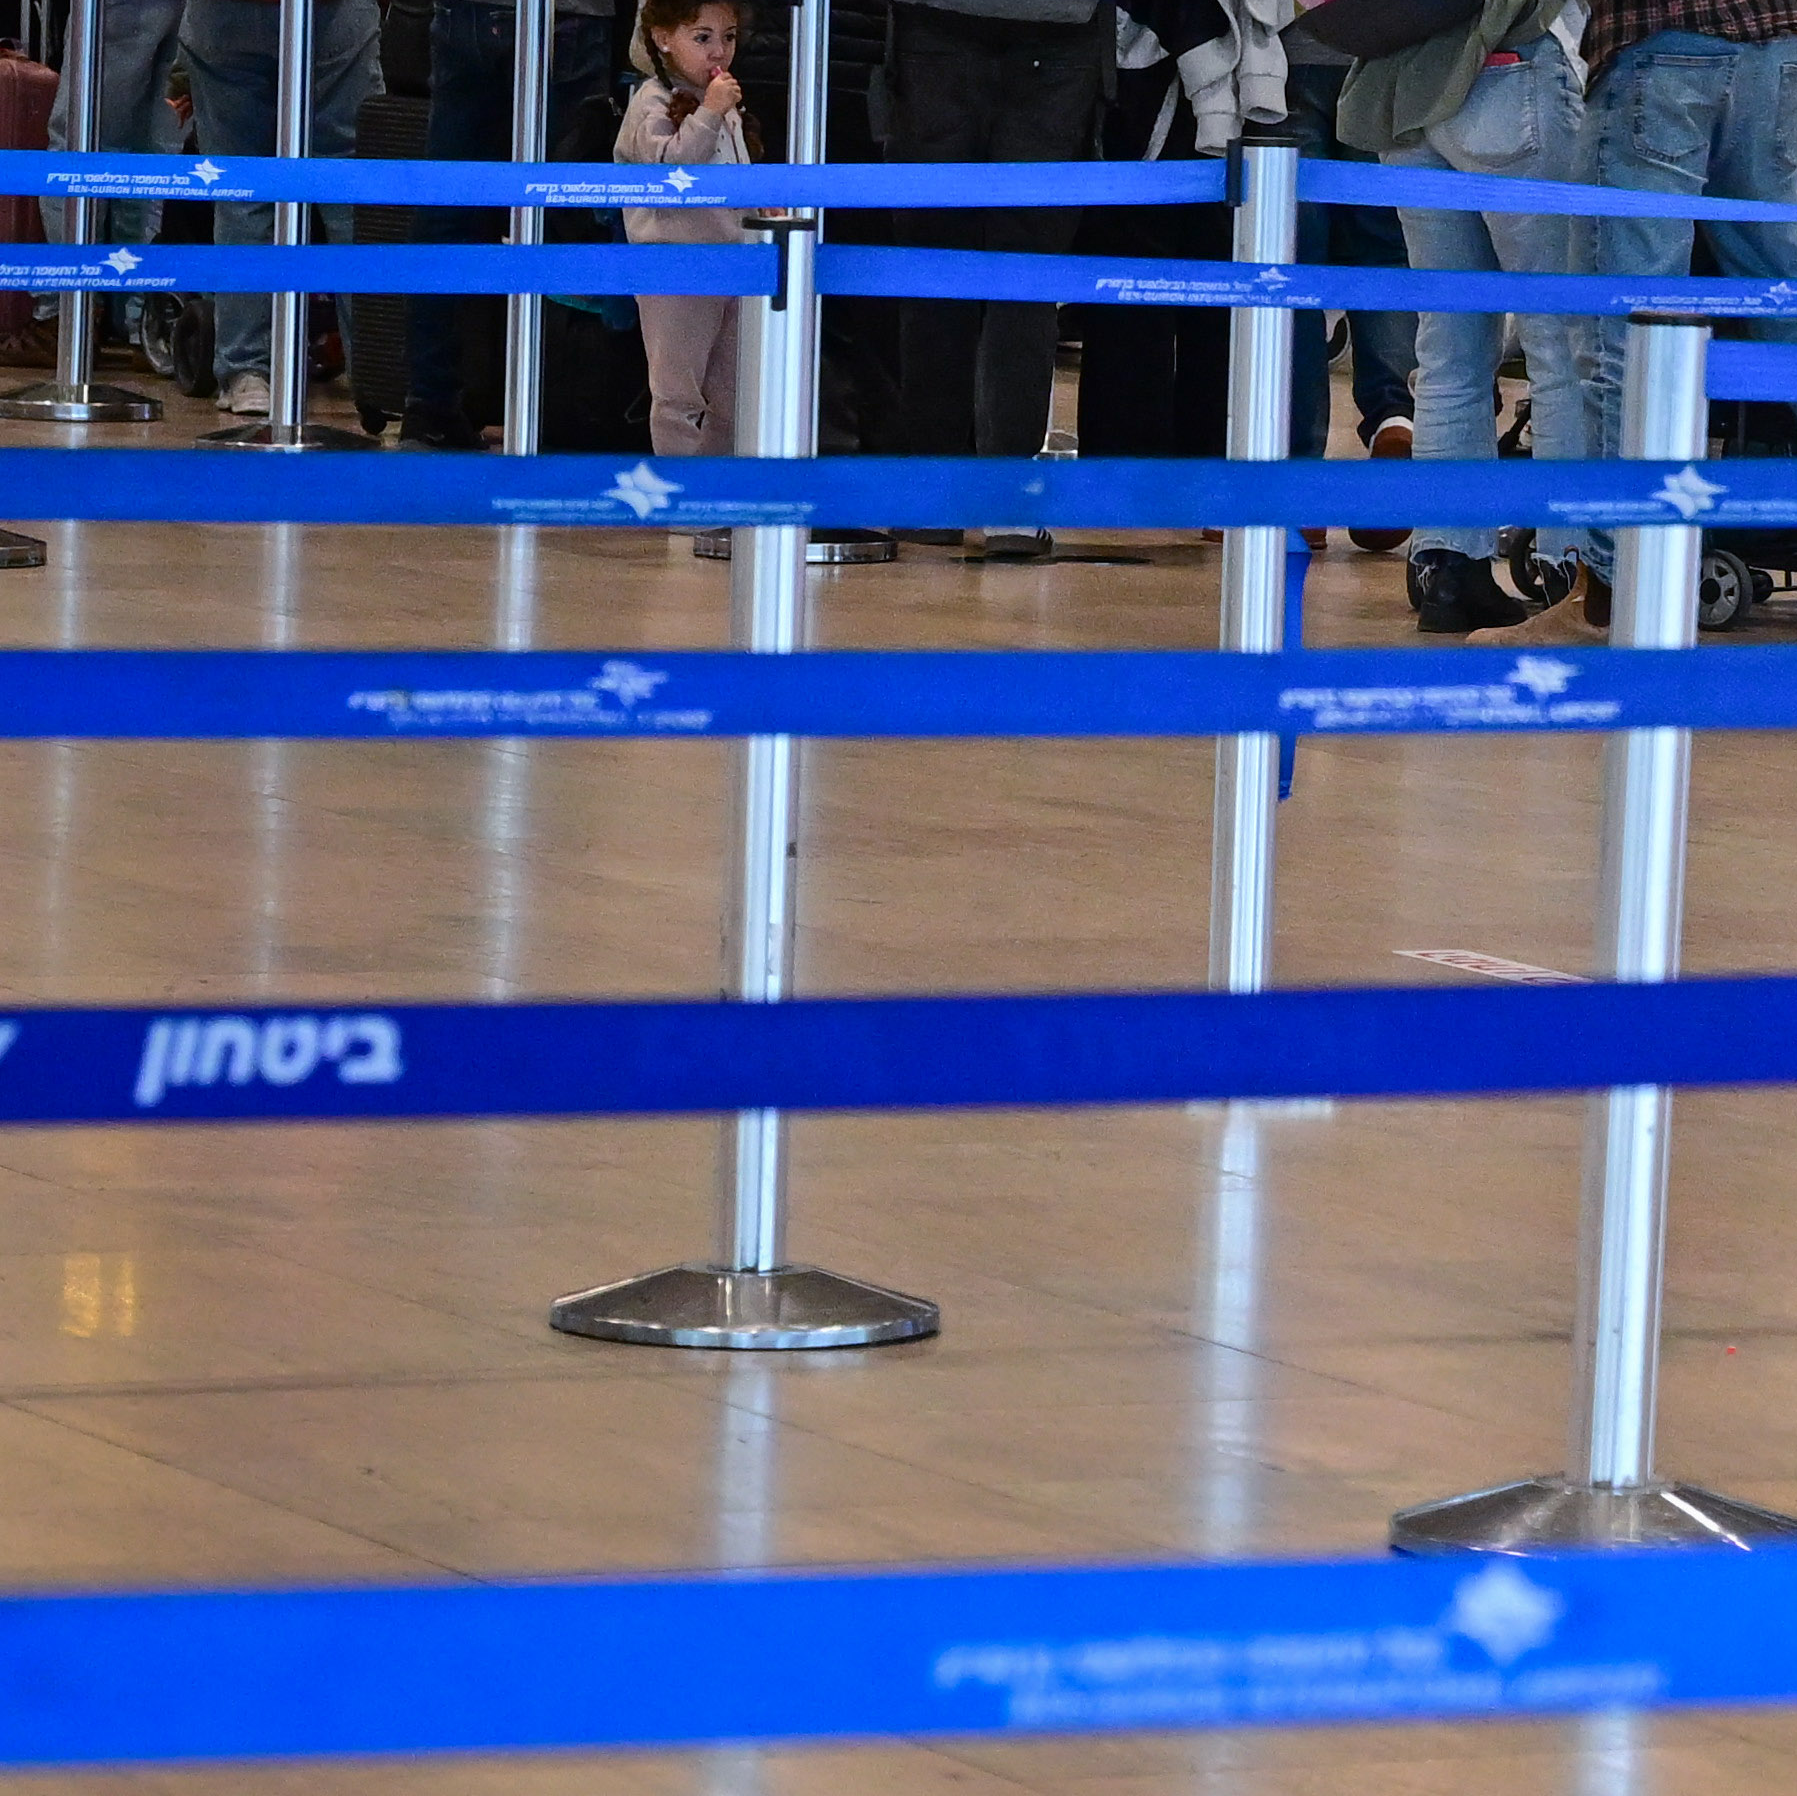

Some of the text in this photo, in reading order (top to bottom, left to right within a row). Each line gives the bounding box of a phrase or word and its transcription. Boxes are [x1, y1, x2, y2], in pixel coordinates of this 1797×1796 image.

[67, 184, 255, 198] BEN-GURION INTERNATIONAL AIRPORT
[545, 194, 728, 205] BEN-GURION INTERNATIONAL AIRPORT
[31, 277, 122, 288] INTERNATIONAL
[125, 277, 177, 287] AIRPORT
[134, 1014, 403, 1107] ביטחון
